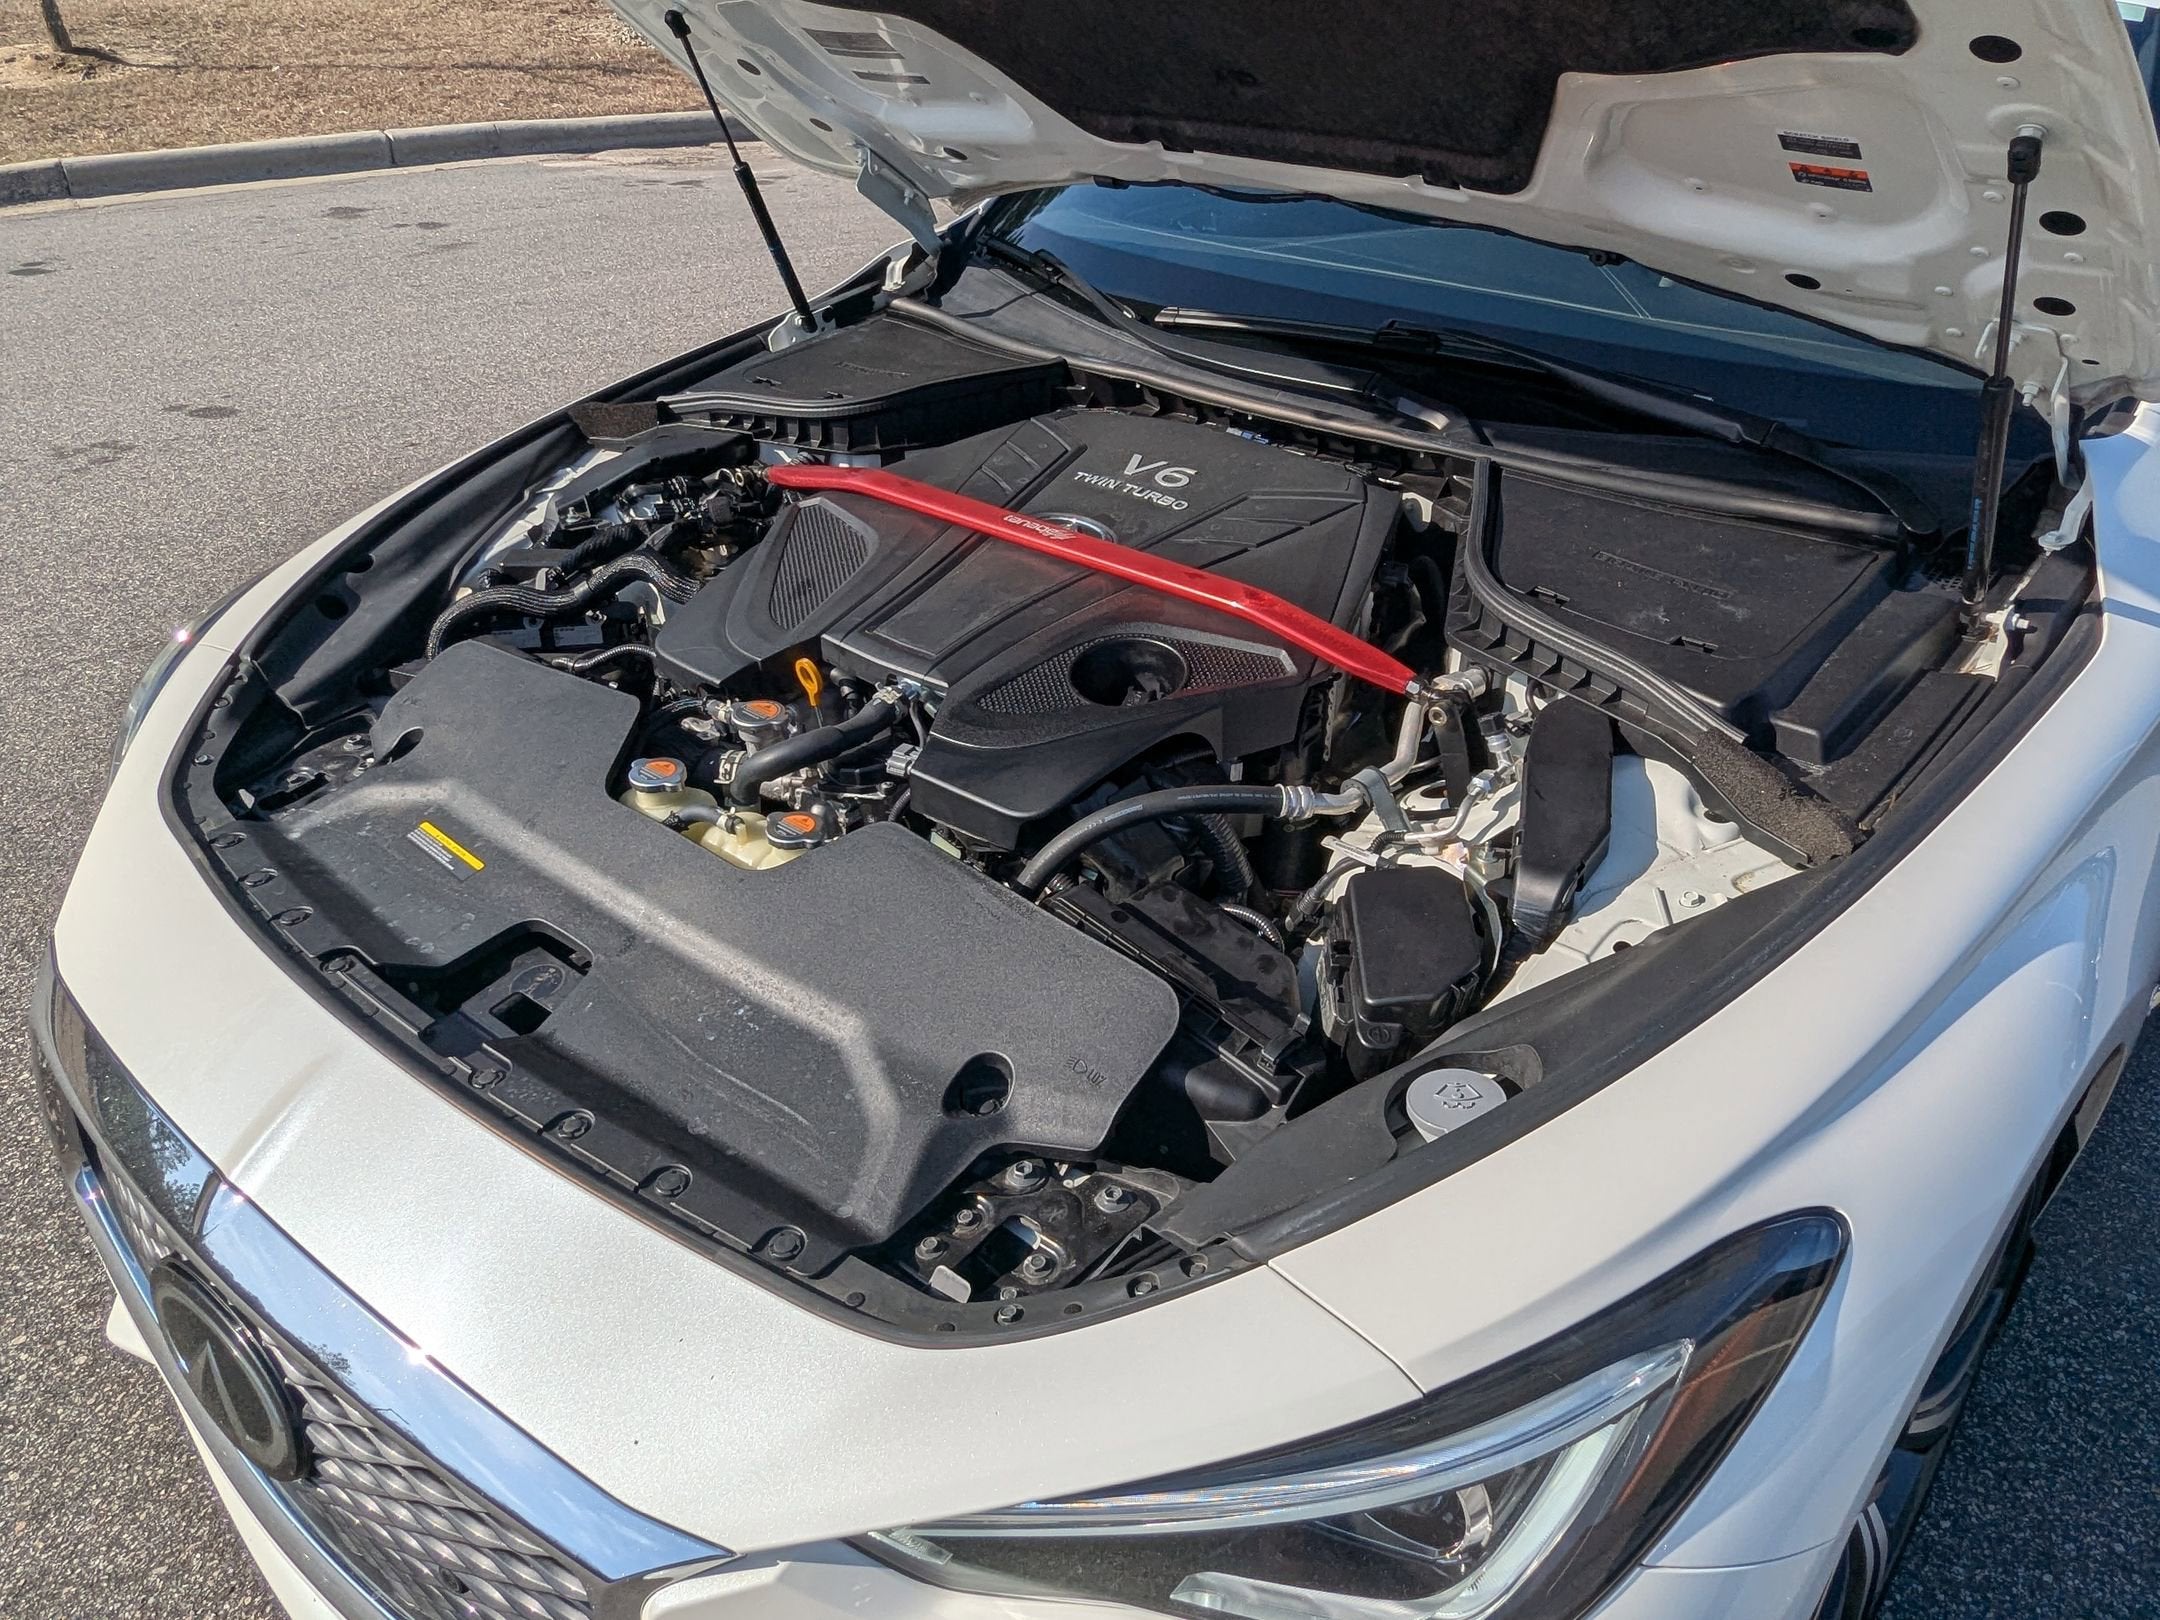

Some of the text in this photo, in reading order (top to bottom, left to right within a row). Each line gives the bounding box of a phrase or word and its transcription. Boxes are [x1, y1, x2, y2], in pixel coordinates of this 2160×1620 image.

[1123, 453, 1199, 488] V6
[1073, 471, 1189, 511] TWIN TURBO
